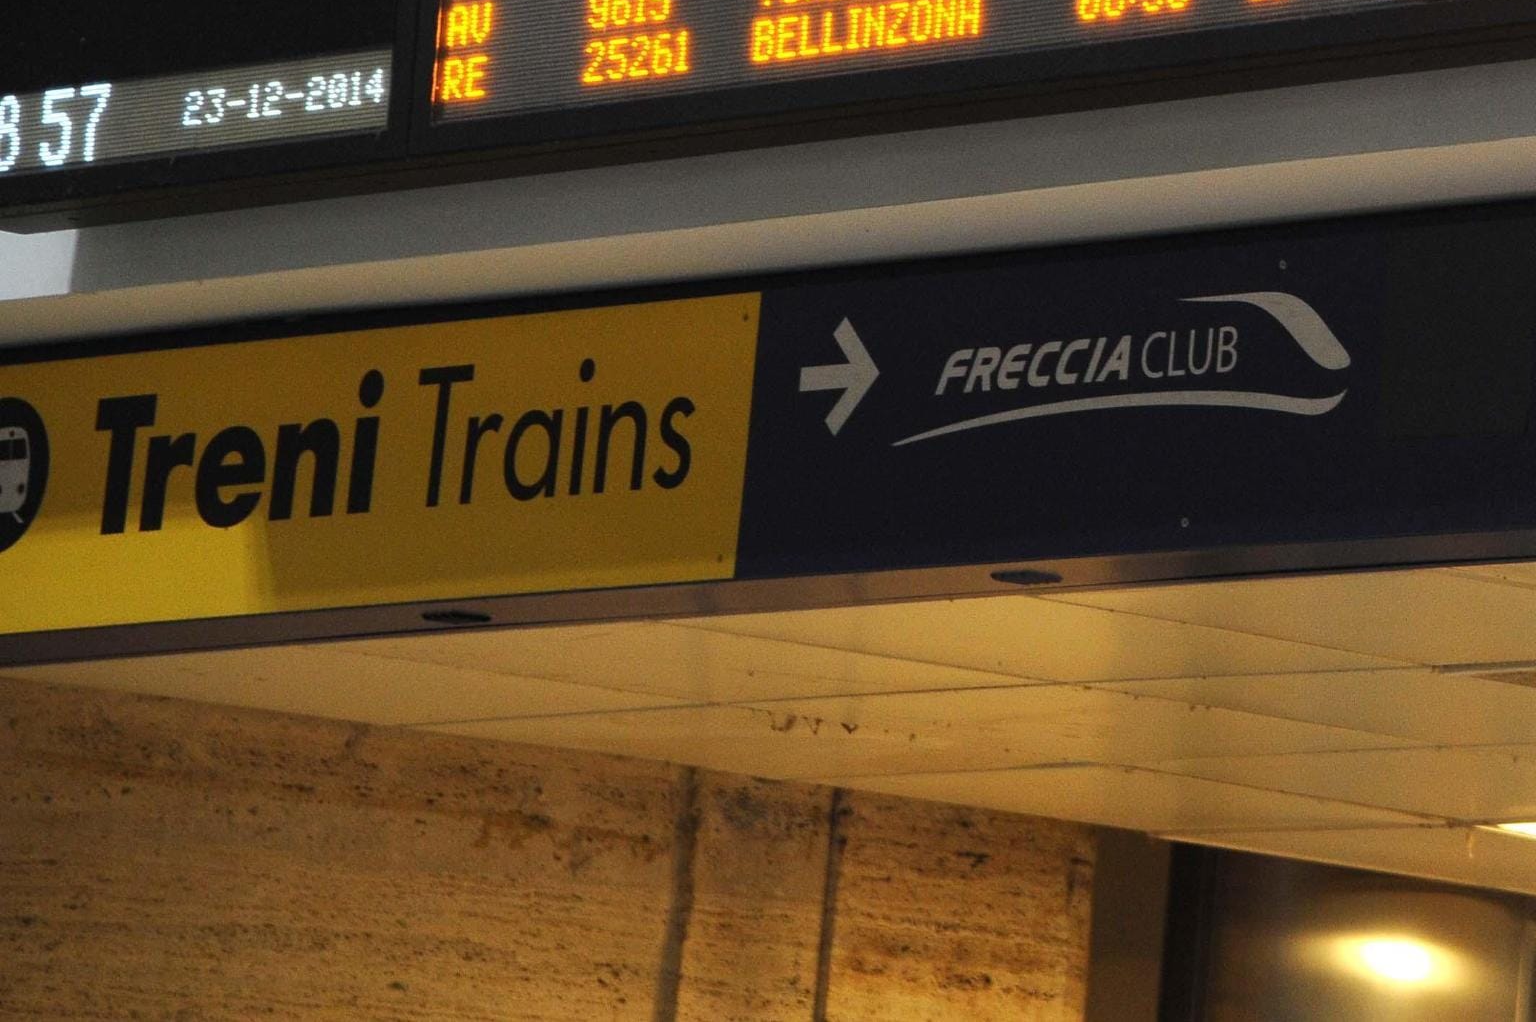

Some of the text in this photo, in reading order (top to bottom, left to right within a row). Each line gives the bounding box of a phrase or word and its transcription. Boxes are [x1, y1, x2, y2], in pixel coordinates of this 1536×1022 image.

[446, 1, 493, 47] AV
[181, 68, 384, 126] 23-12-2014
[441, 55, 489, 100] RE
[582, 30, 689, 83] 25261
[95, 359, 695, 535] Treni Trains
